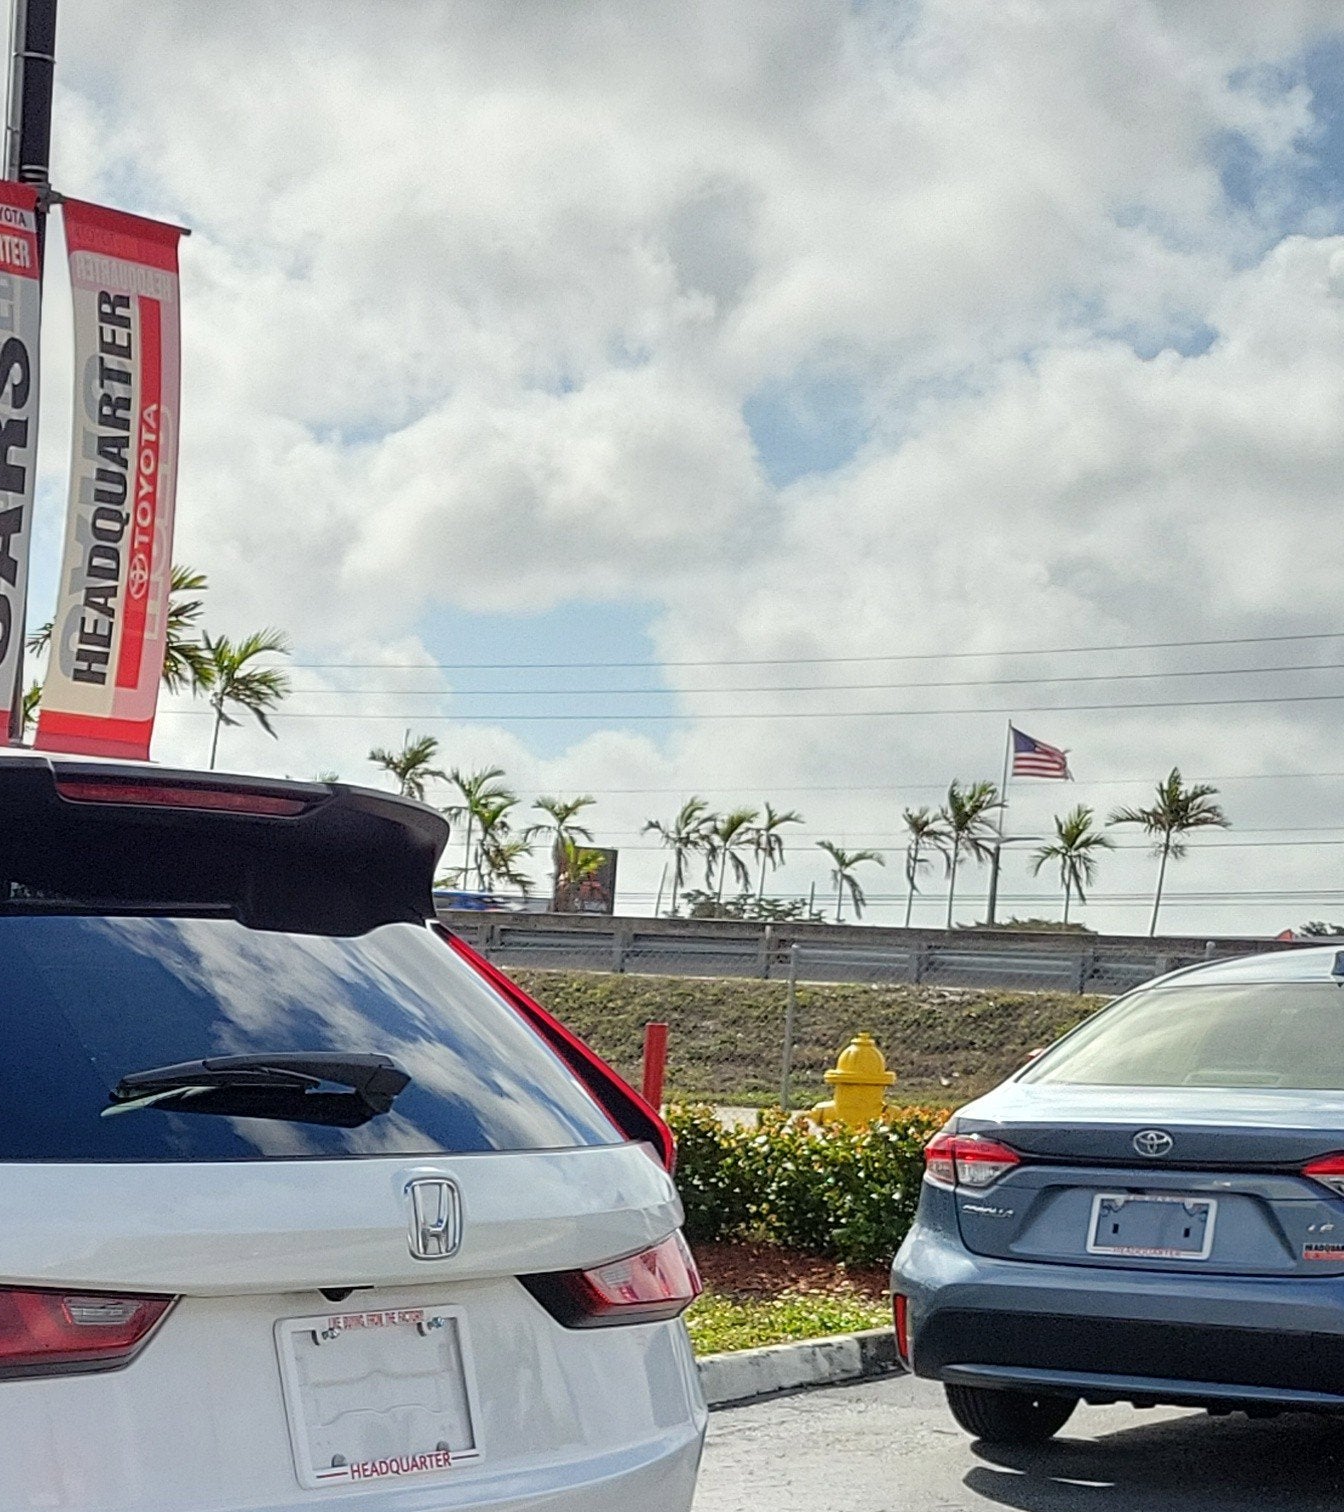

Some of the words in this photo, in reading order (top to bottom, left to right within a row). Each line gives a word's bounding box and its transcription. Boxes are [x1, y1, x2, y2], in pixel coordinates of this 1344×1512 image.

[72, 290, 133, 685] HEADQUARTER
[133, 403, 160, 549] TOYOTA
[349, 1451, 452, 1480] HEADQUARTER
